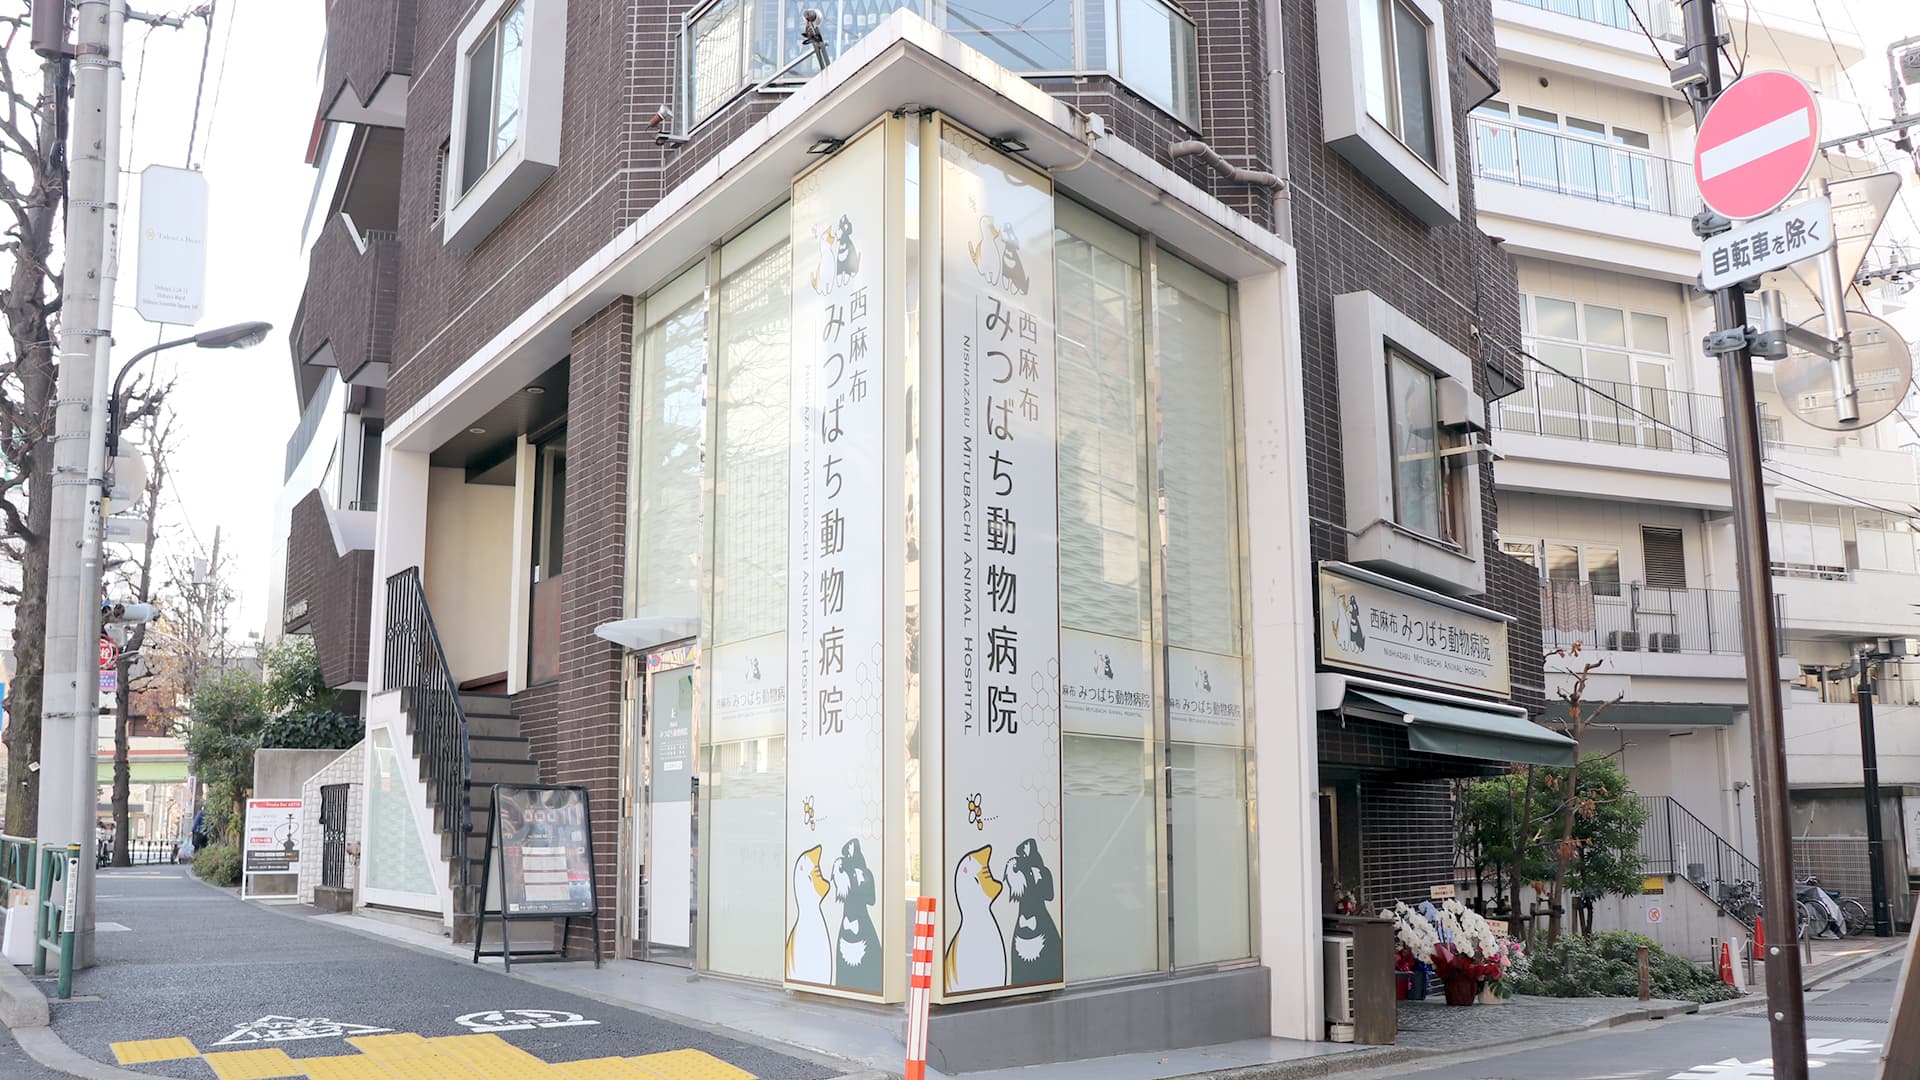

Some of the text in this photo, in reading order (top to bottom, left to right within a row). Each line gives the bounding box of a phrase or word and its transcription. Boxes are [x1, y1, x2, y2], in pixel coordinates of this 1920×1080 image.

[1712, 218, 1819, 276] 自転車を除く
[849, 286, 868, 403] 西麻布
[1018, 309, 1039, 423] 西麻布
[801, 459, 811, 561] MITUBACHI
[818, 303, 845, 737] みつばち動物病院
[962, 335, 973, 736] NISHIAZABU MITUBACHI ANIMAL HOSPITAL
[985, 295, 1018, 735] みつばち動物病院
[801, 570, 810, 638] ANIMAL
[1370, 607, 1491, 661] 西麻布 みつばち動物病院
[800, 648, 810, 742] HOSPITAL
[1062, 684, 1076, 697] 麻布
[1078, 685, 1150, 708] みつばち動物病院
[1413, 653, 1442, 668] MITUBACHI
[1182, 698, 1241, 718] みつばち動物病院
